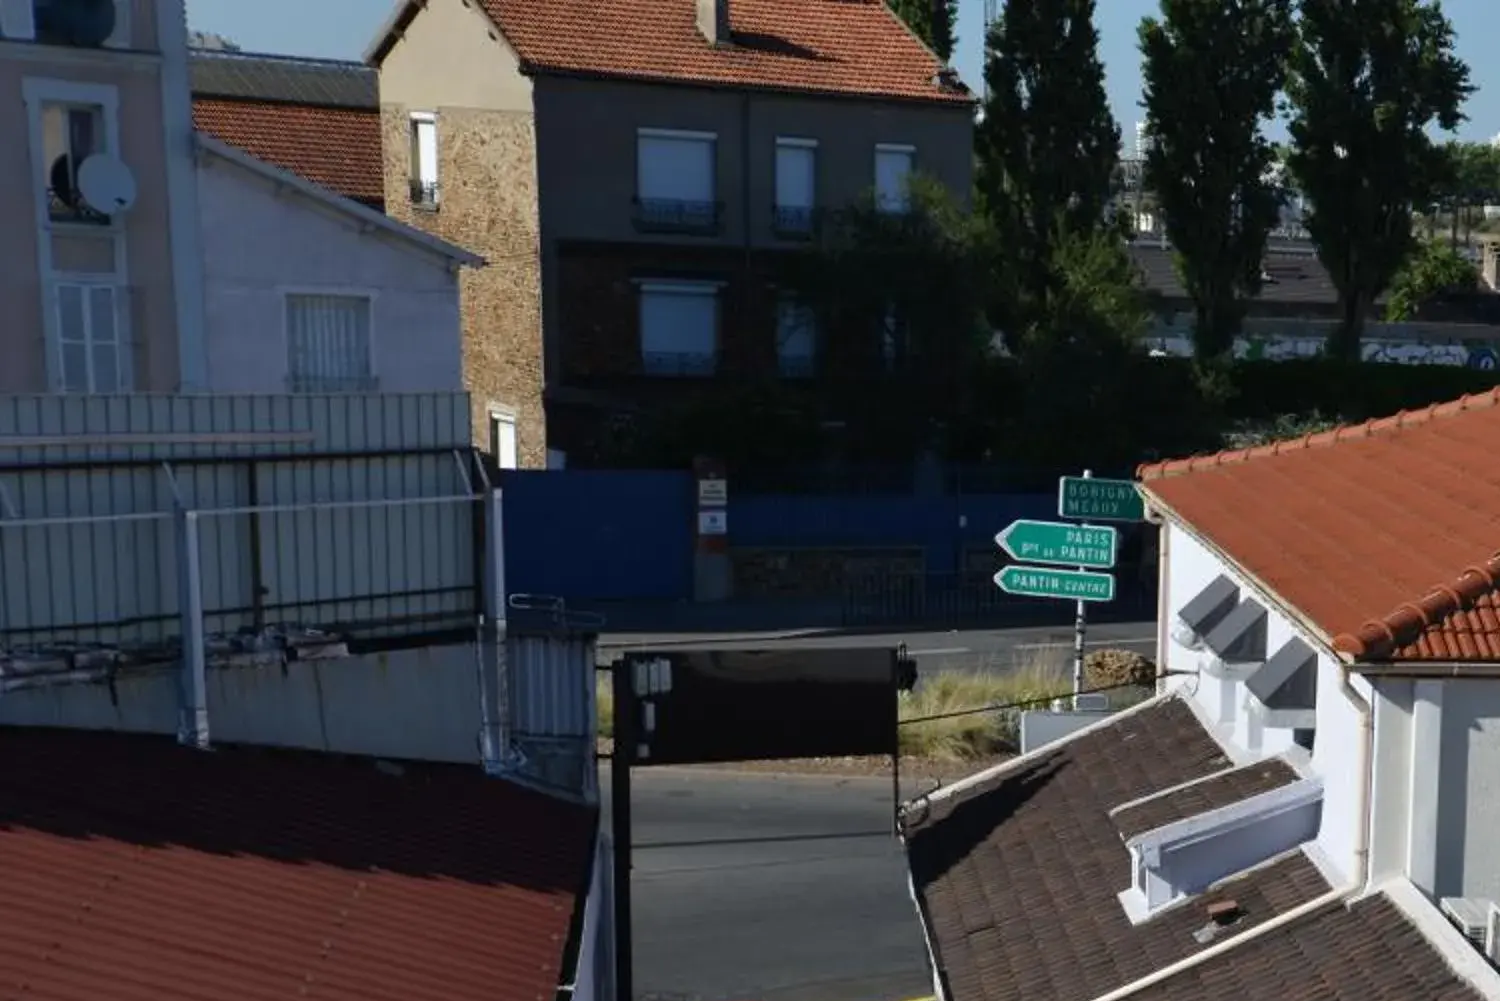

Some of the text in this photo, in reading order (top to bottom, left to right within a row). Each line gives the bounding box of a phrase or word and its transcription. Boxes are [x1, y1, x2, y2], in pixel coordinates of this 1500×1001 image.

[1068, 498, 1119, 513] MEAUX
[1066, 531, 1110, 547] PARIS
[1061, 545, 1109, 561] PANTIN
[1012, 574, 1108, 594] PANTIN CENTRE
